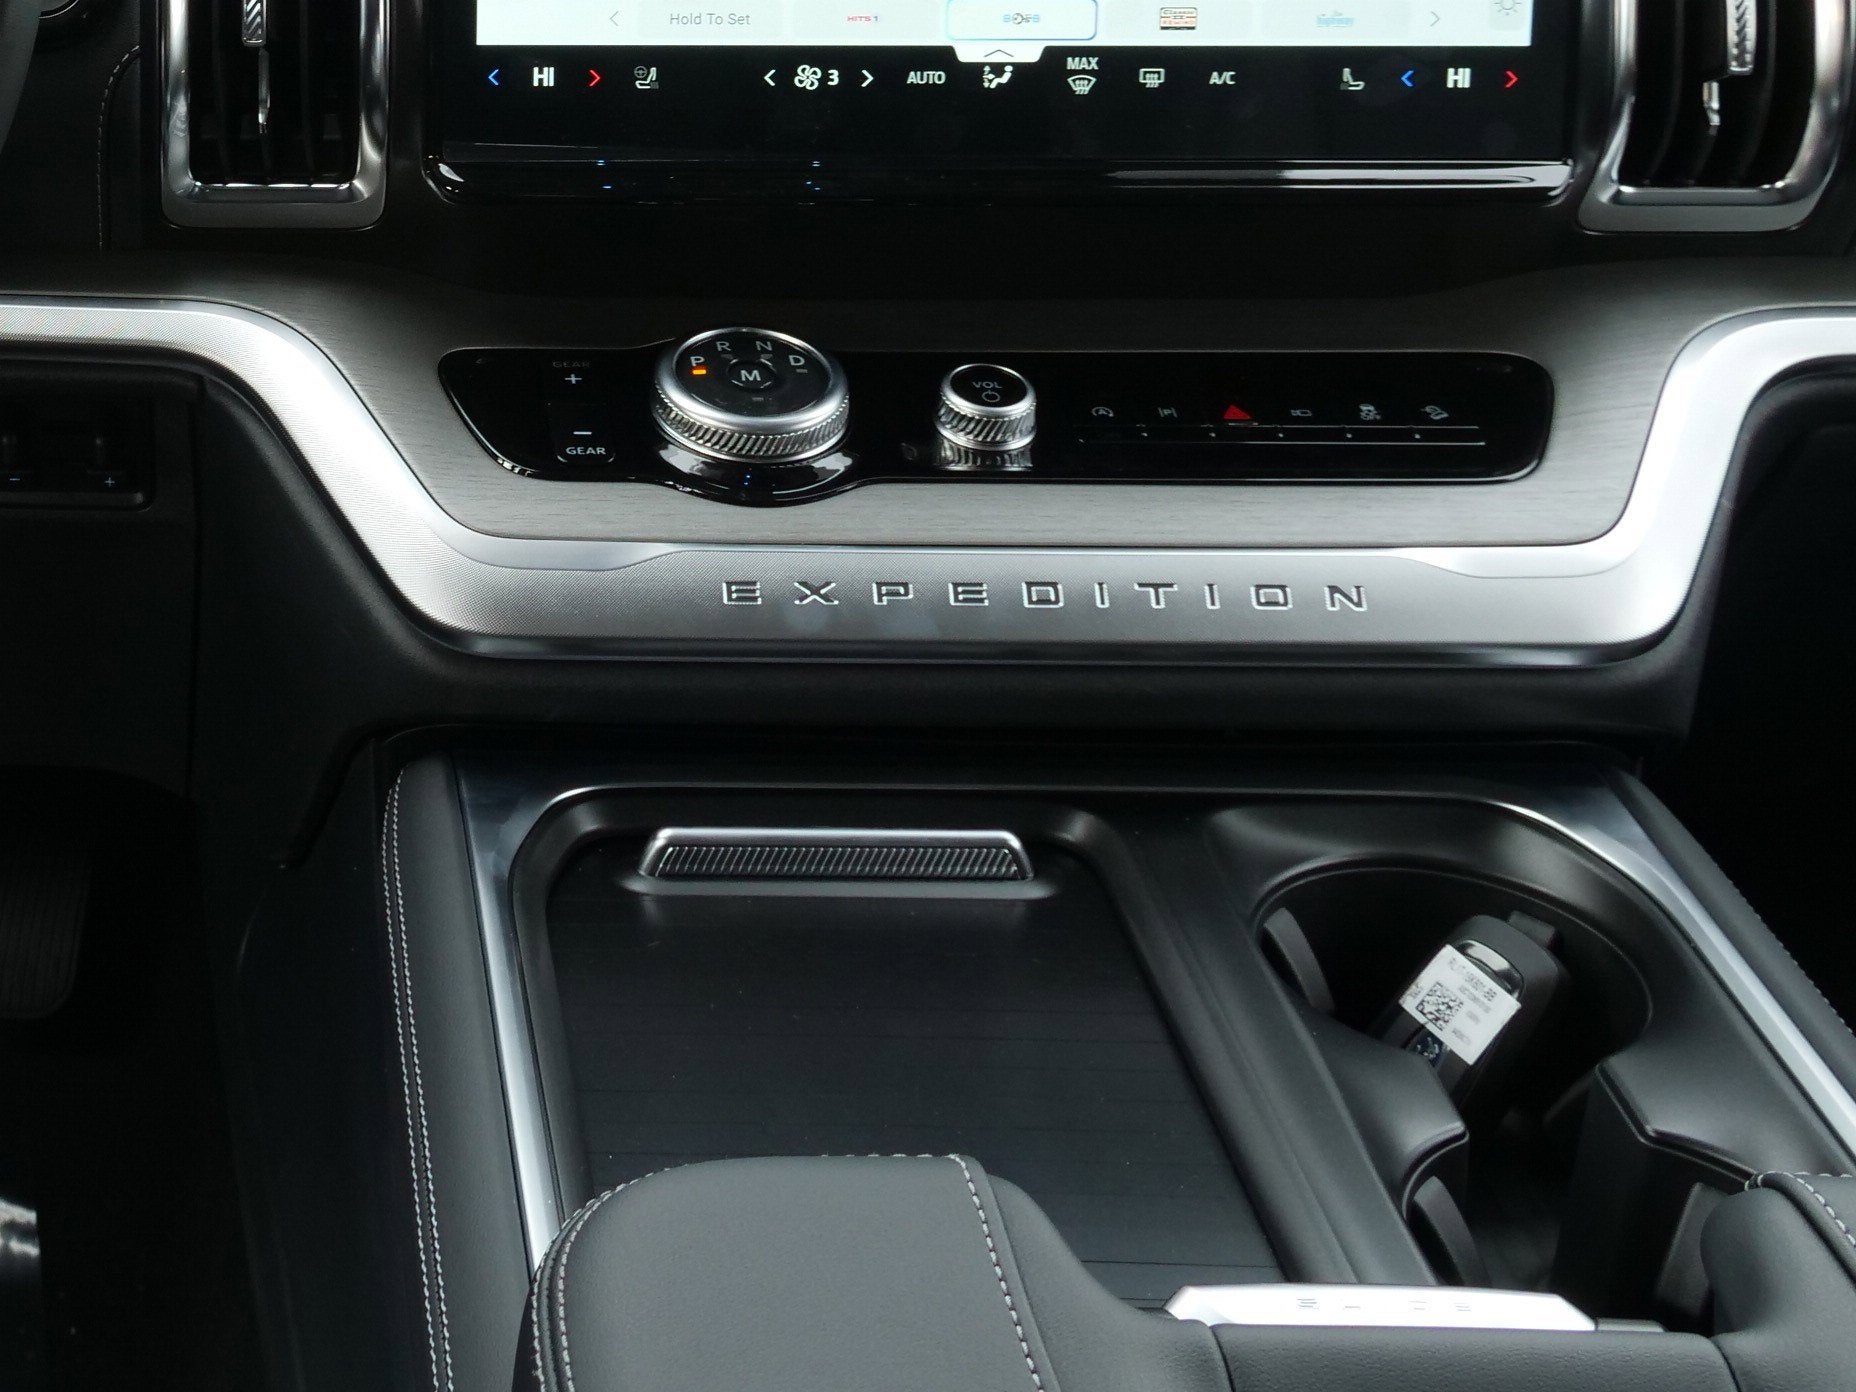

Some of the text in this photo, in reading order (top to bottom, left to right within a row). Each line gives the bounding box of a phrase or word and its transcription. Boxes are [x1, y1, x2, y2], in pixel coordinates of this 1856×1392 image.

[669, 12, 751, 26] Hold To Set
[1067, 58, 1099, 70] MAX
[533, 67, 555, 87] HI
[828, 72, 840, 86] 3
[907, 72, 946, 85] AUTO
[1209, 72, 1236, 85] A/C
[1447, 68, 1471, 88] HI
[716, 341, 772, 352] R N
[691, 356, 805, 382] P M D
[972, 381, 1002, 389] VOL
[565, 446, 606, 456] GEAR
[722, 581, 1368, 612] EXPEDITION
